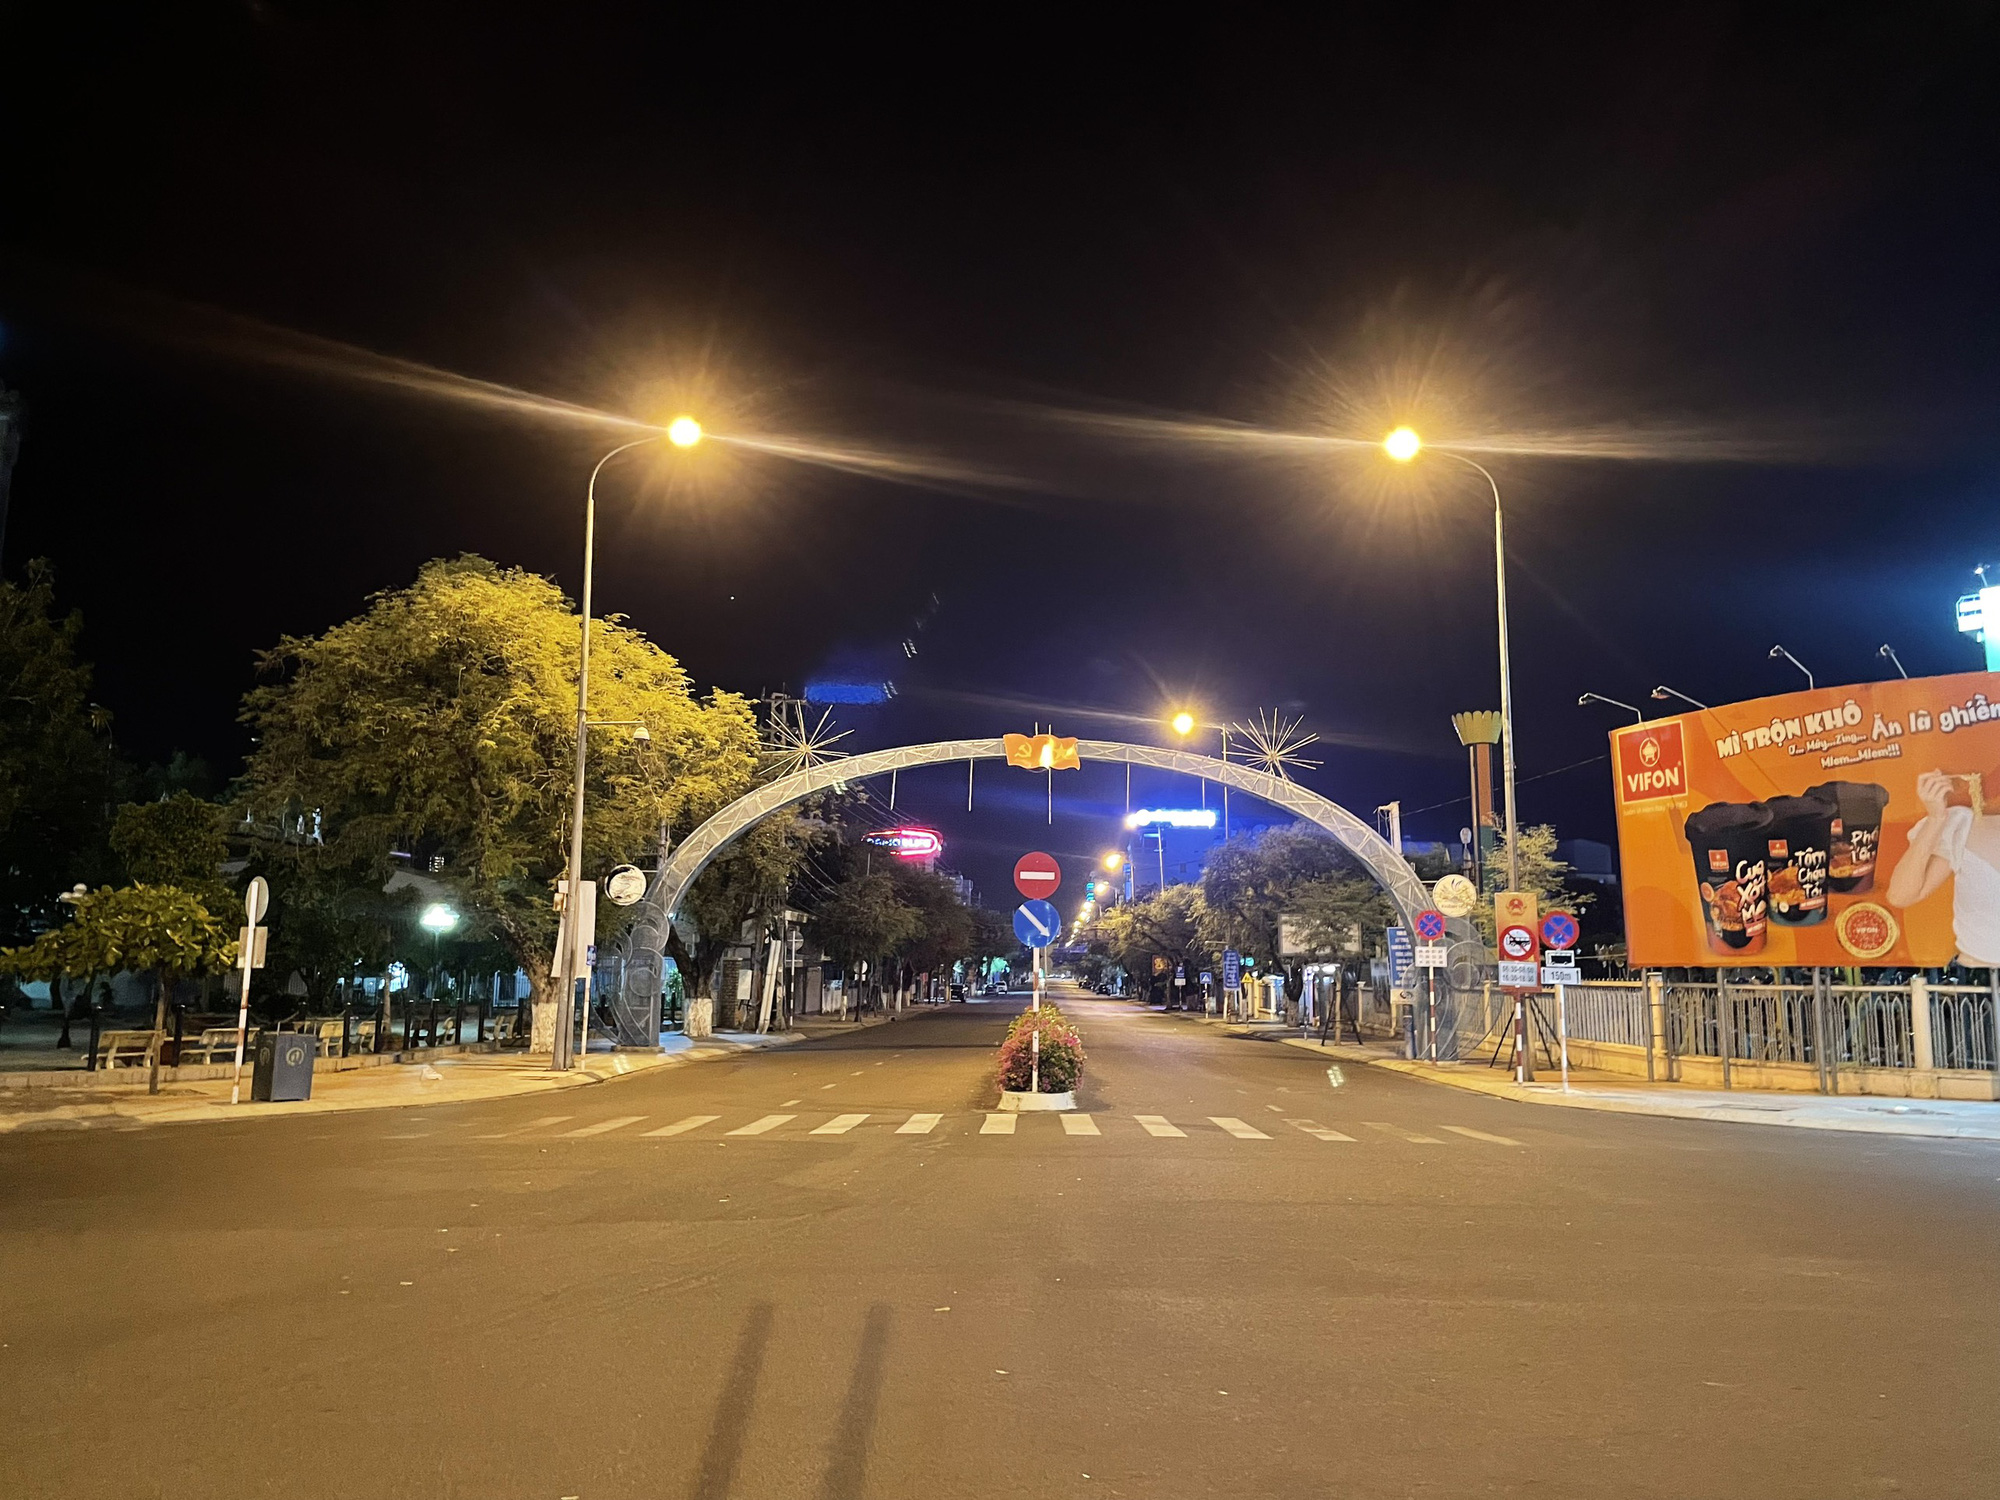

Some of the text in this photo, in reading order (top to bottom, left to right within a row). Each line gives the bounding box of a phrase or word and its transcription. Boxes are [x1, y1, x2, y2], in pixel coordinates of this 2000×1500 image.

[1716, 699, 1863, 759] MÌ TRỘN KHÔ
[1871, 712, 1903, 742] Ăn
[1908, 709, 1932, 733] là
[1626, 766, 1680, 793] VIFON
[1794, 846, 1827, 868] Tôm
[1550, 971, 1572, 981] 150m
